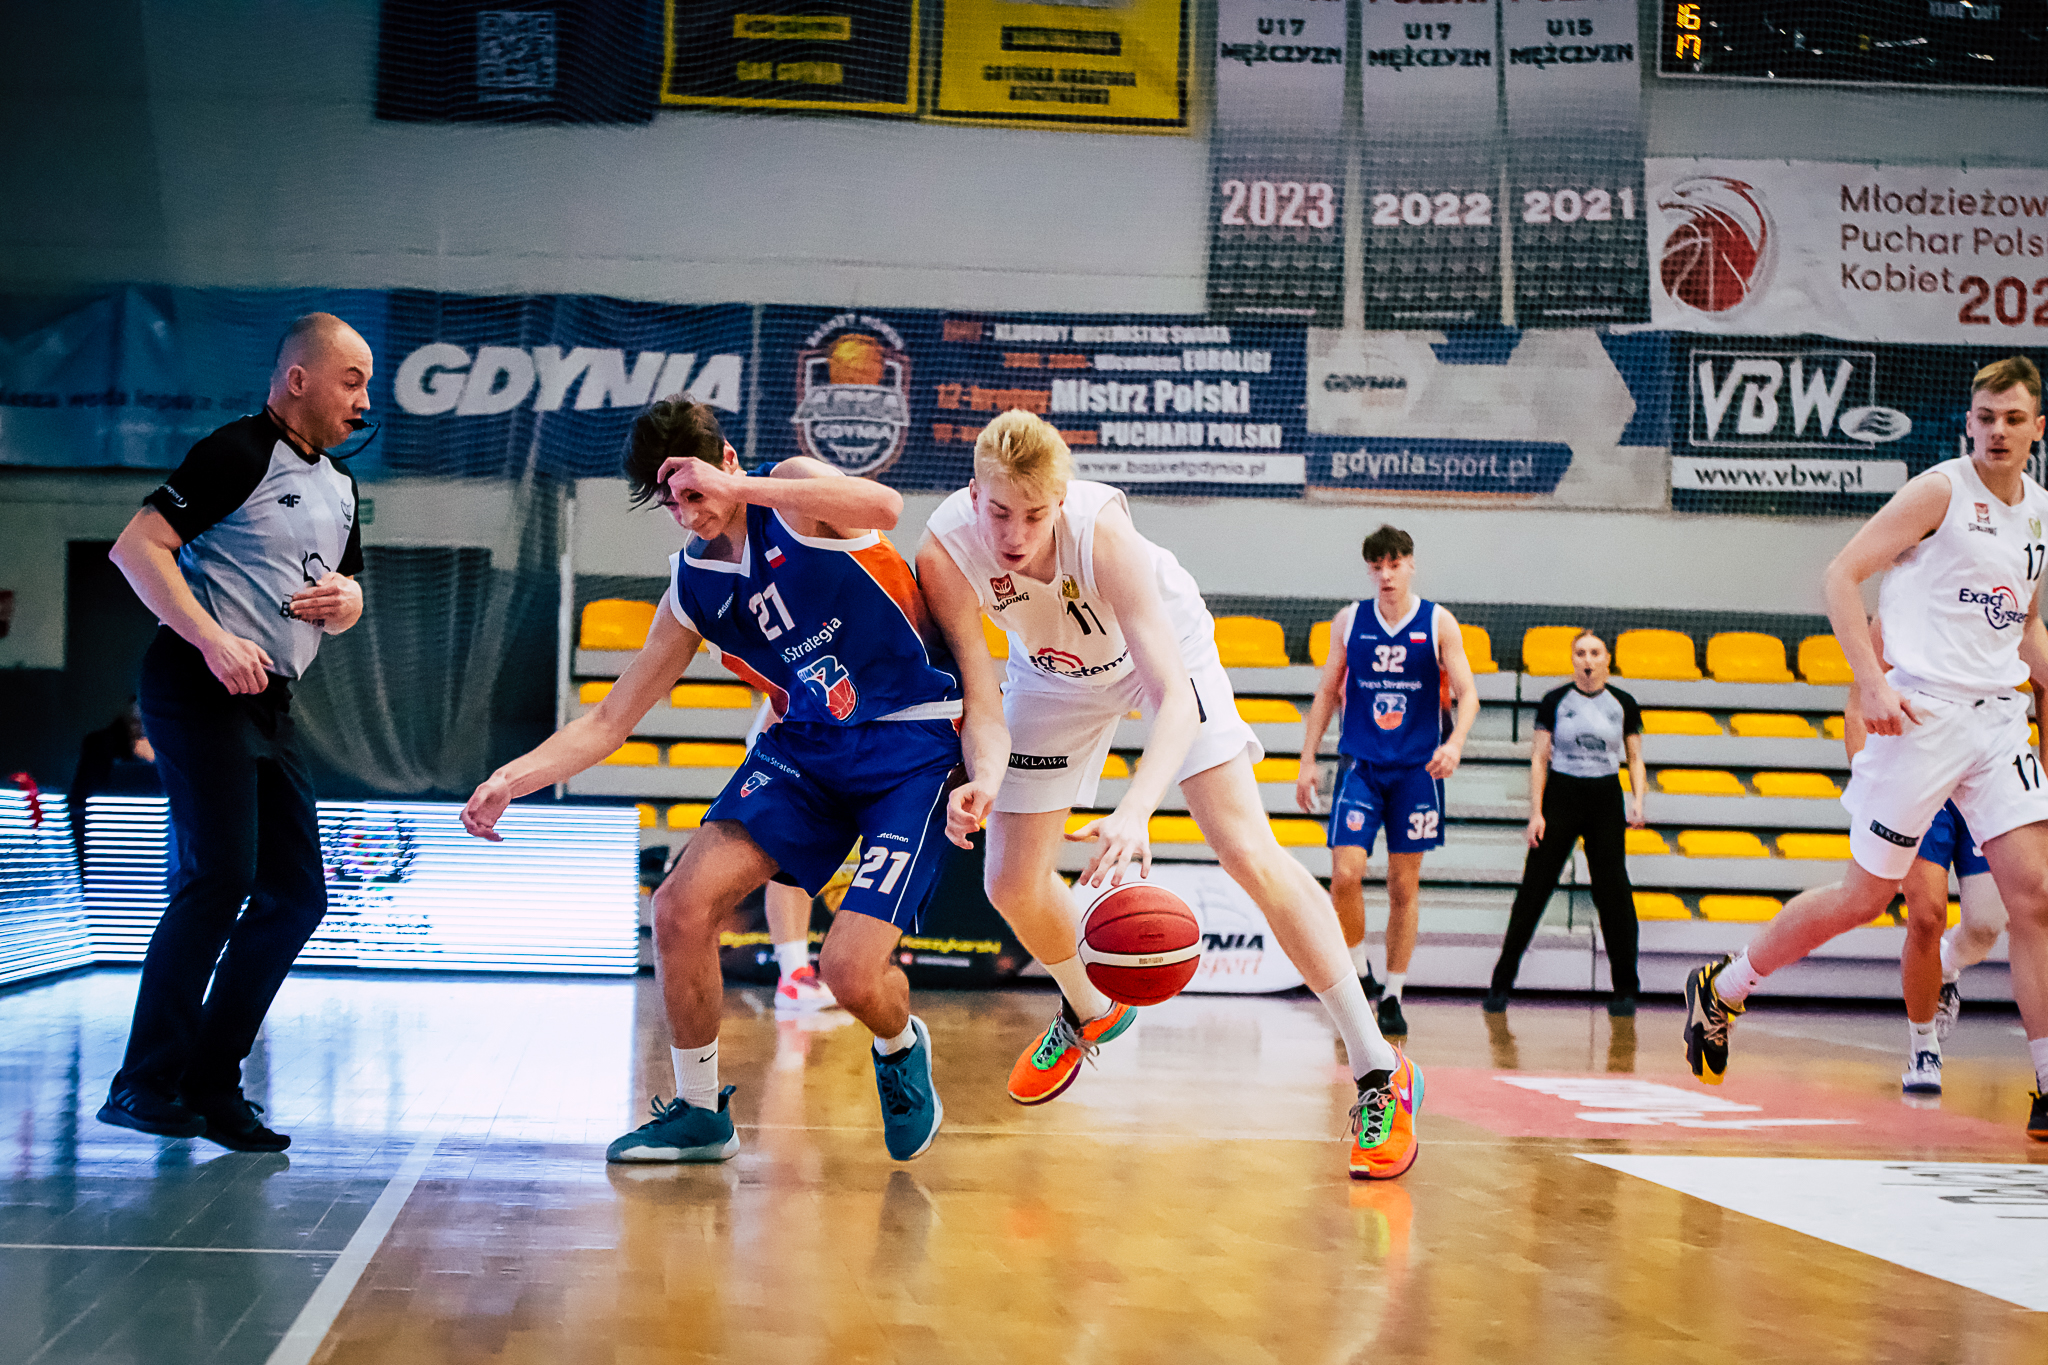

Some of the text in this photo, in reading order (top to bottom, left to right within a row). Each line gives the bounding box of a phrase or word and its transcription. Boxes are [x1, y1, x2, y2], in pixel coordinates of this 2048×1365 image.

[1257, 18, 1305, 37] U17
[1404, 22, 1452, 41] U17
[1546, 18, 1594, 37] U15
[1221, 180, 1335, 229] 2023
[1372, 191, 1493, 227] 2022
[1523, 186, 1636, 224] 2021
[1840, 223, 2048, 258] Puchar Pols
[1840, 262, 1954, 294] Kobiet
[394, 341, 743, 416] GDYNIA
[1051, 378, 1148, 414] Mistrz
[1154, 379, 1250, 414] Polski
[1698, 357, 1854, 438] VBW
[1100, 421, 1203, 447] PUCHARU
[1207, 422, 1283, 449] POLSKI
[1330, 447, 1535, 481] gdyniasport.pl
[1694, 463, 1864, 493] www.vbw.pl
[277, 493, 302, 509] 4F
[2023, 543, 2046, 581] 17
[748, 581, 796, 641] 21
[992, 591, 1030, 613] PALDING
[1958, 587, 2005, 607] Exact
[1066, 600, 1107, 636] 11
[785, 617, 842, 661] Strategia
[1371, 644, 1408, 674] 32
[1010, 754, 1066, 767] NKLAWA
[1406, 810, 1440, 841] 32
[851, 845, 913, 895] 21
